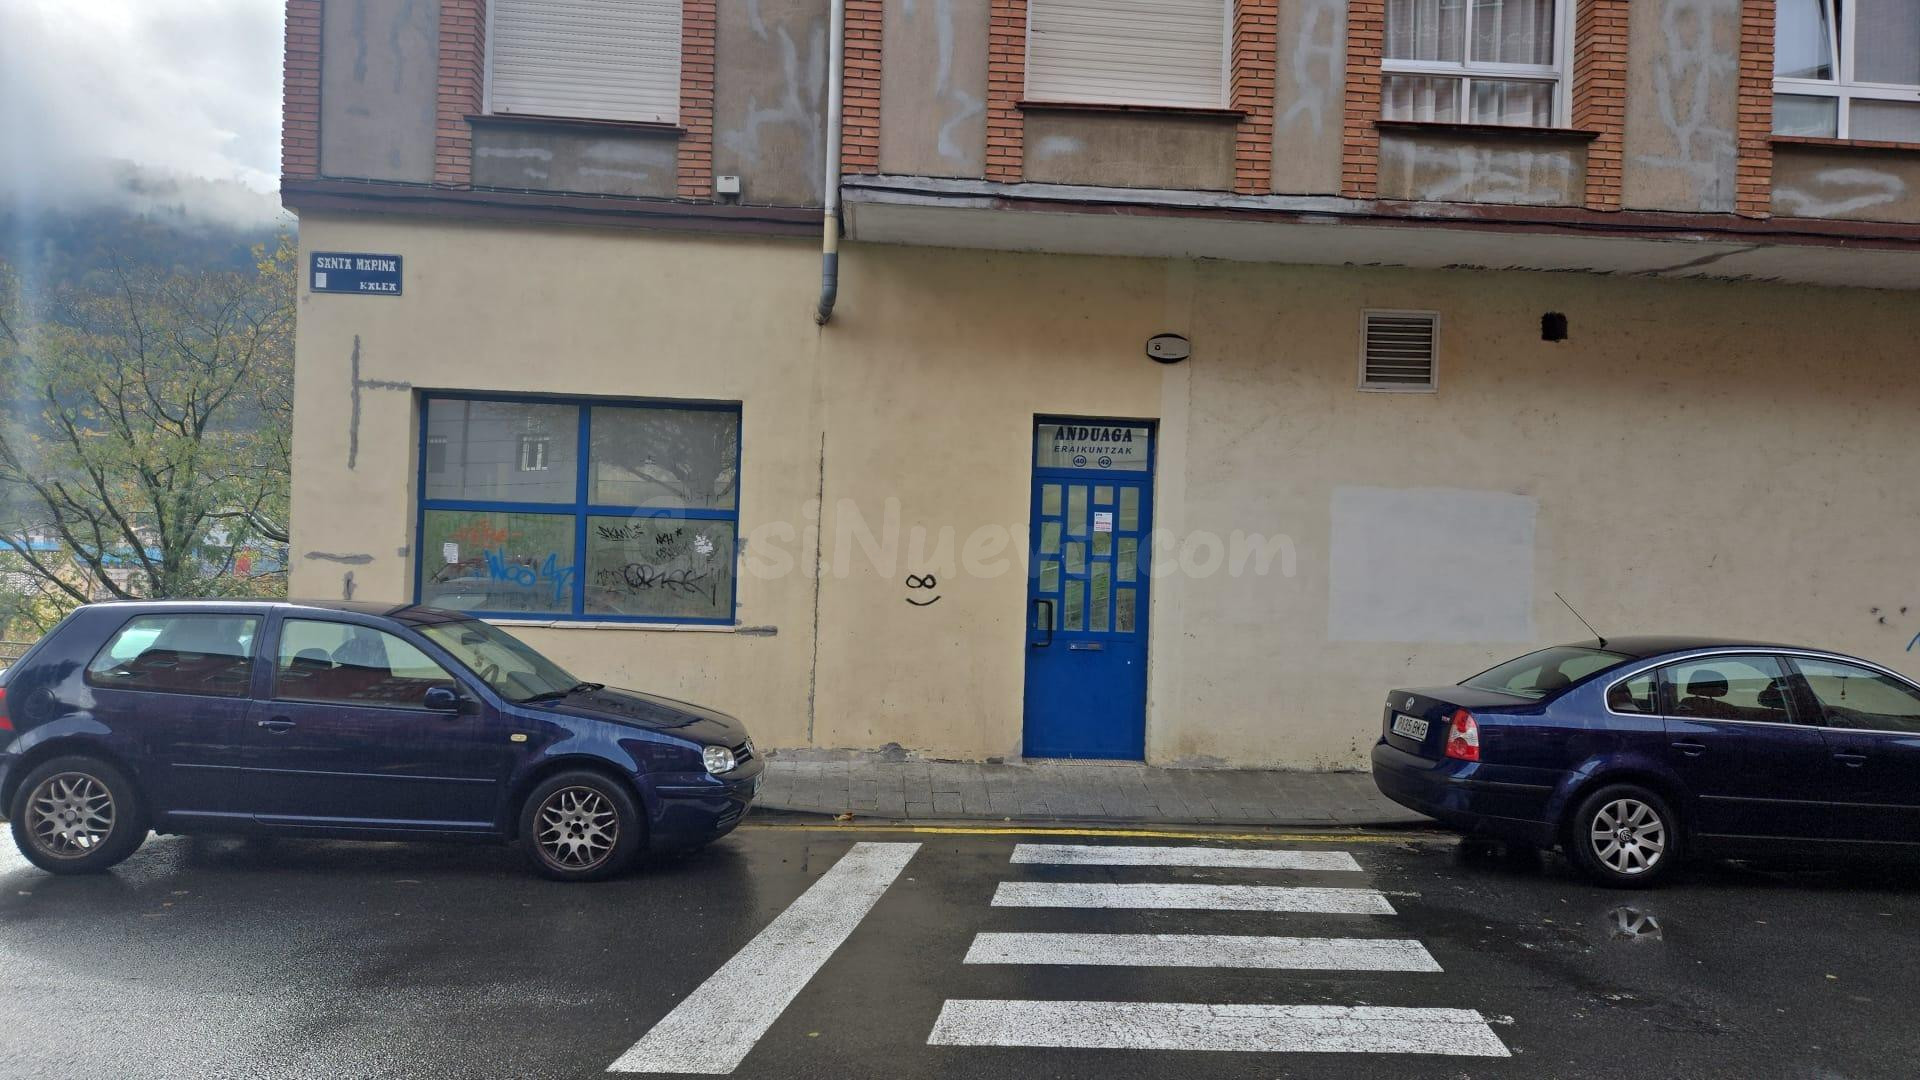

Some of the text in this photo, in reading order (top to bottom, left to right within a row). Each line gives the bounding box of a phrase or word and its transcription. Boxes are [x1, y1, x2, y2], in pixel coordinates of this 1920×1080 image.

[317, 256, 396, 272] SANTA MARINA
[360, 281, 397, 291] KALEA
[1055, 427, 1132, 442] ANDUAGA
[1054, 445, 1133, 455] ERAIKUNTZAK
